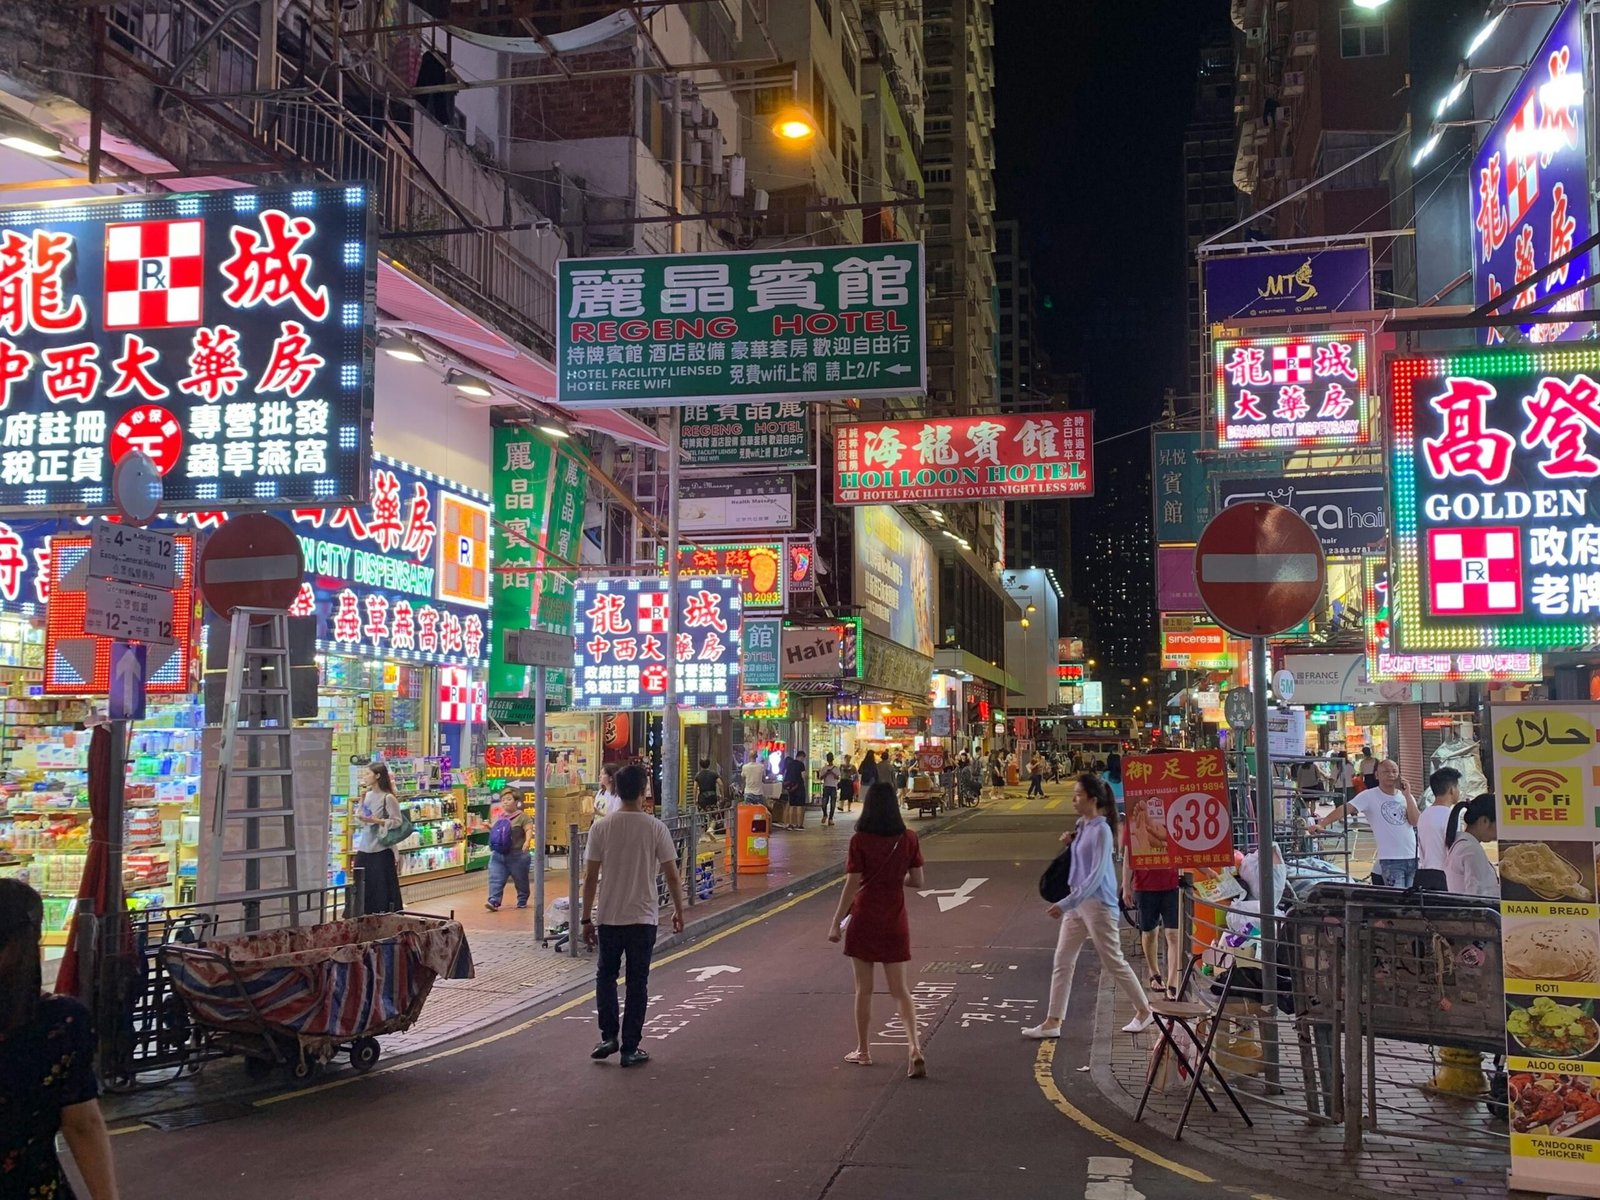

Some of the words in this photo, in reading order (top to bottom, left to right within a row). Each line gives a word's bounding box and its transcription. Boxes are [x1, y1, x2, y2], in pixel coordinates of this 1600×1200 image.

[219, 209, 329, 322] 城
[568, 255, 912, 319] 麗晶賓館
[571, 317, 738, 343] REGENG
[773, 310, 907, 336] HOTEL
[567, 344, 643, 366] 持牌賓館
[649, 342, 726, 363] 酒店設備
[731, 338, 808, 360] 豪華套房
[813, 335, 911, 357] 歡迎自由行
[1314, 342, 1358, 381] 城
[567, 369, 608, 380] HOTEL
[611, 367, 667, 379] FACILITY
[670, 365, 722, 377] LIENSED
[1225, 348, 1272, 386] 龍
[567, 381, 608, 392] HOTEL
[611, 380, 640, 391] FREE
[644, 379, 671, 390] WIFI
[1232, 383, 1354, 421] 大藥房
[189, 399, 329, 440] 專營批發
[682, 423, 743, 437] REGENG
[754, 421, 803, 434] HOTEL
[1227, 424, 1270, 439] DRAGON
[1271, 423, 1295, 437] CITY
[1296, 420, 1359, 436] DISPENSARY
[864, 419, 1060, 468] 海龍賓館
[1063, 416, 1073, 460] 全日特平
[187, 439, 327, 477] 蟲草燕窩
[839, 470, 894, 490] HOI
[899, 465, 979, 488] LOON
[987, 462, 1086, 484] HOTEL
[863, 489, 900, 500] HOTEL
[902, 487, 964, 499] FACILITEIS
[966, 485, 997, 497] OVER
[999, 484, 1037, 496] NIGHT
[1039, 482, 1067, 493] LESS
[1069, 481, 1086, 491] 20%
[502, 442, 535, 589] 麗晶賓館
[1285, 504, 1343, 530] ca
[1425, 489, 1588, 521] GOLDEN
[159, 540, 171, 557] 12
[317, 541, 350, 579] CITY
[354, 550, 434, 597] DISPENSARY
[755, 591, 778, 602] 2093
[334, 588, 483, 659] 蟲草燕窩批發
[586, 593, 632, 634] 龍
[684, 590, 727, 632] 城
[159, 621, 172, 638] 12
[748, 624, 774, 649] 館
[1169, 636, 1207, 644] sincere
[587, 632, 725, 663] 中西大藥房
[786, 637, 834, 664] Hair
[1379, 654, 1451, 672] 政府註冊
[1457, 653, 1530, 671] 信心保證
[1280, 679, 1294, 694] 5M
[1502, 717, 1590, 753] حلال
[504, 767, 535, 777] PALACE
[1126, 755, 1225, 784] 御足苑
[1180, 784, 1200, 793] 6491
[1504, 794, 1528, 805] Wi
[1552, 794, 1570, 805] Fi
[1173, 798, 1220, 842] $38
[1510, 808, 1568, 820] FREE
[1507, 904, 1539, 914] NAAN
[1549, 906, 1589, 916] BREAD
[1535, 983, 1559, 993] ROTI
[1526, 1059, 1560, 1070] ALOO
[1563, 1061, 1584, 1072] GOBI
[1531, 1139, 1593, 1152] TANDOORIE
[1538, 1148, 1585, 1160] CHICKEN
